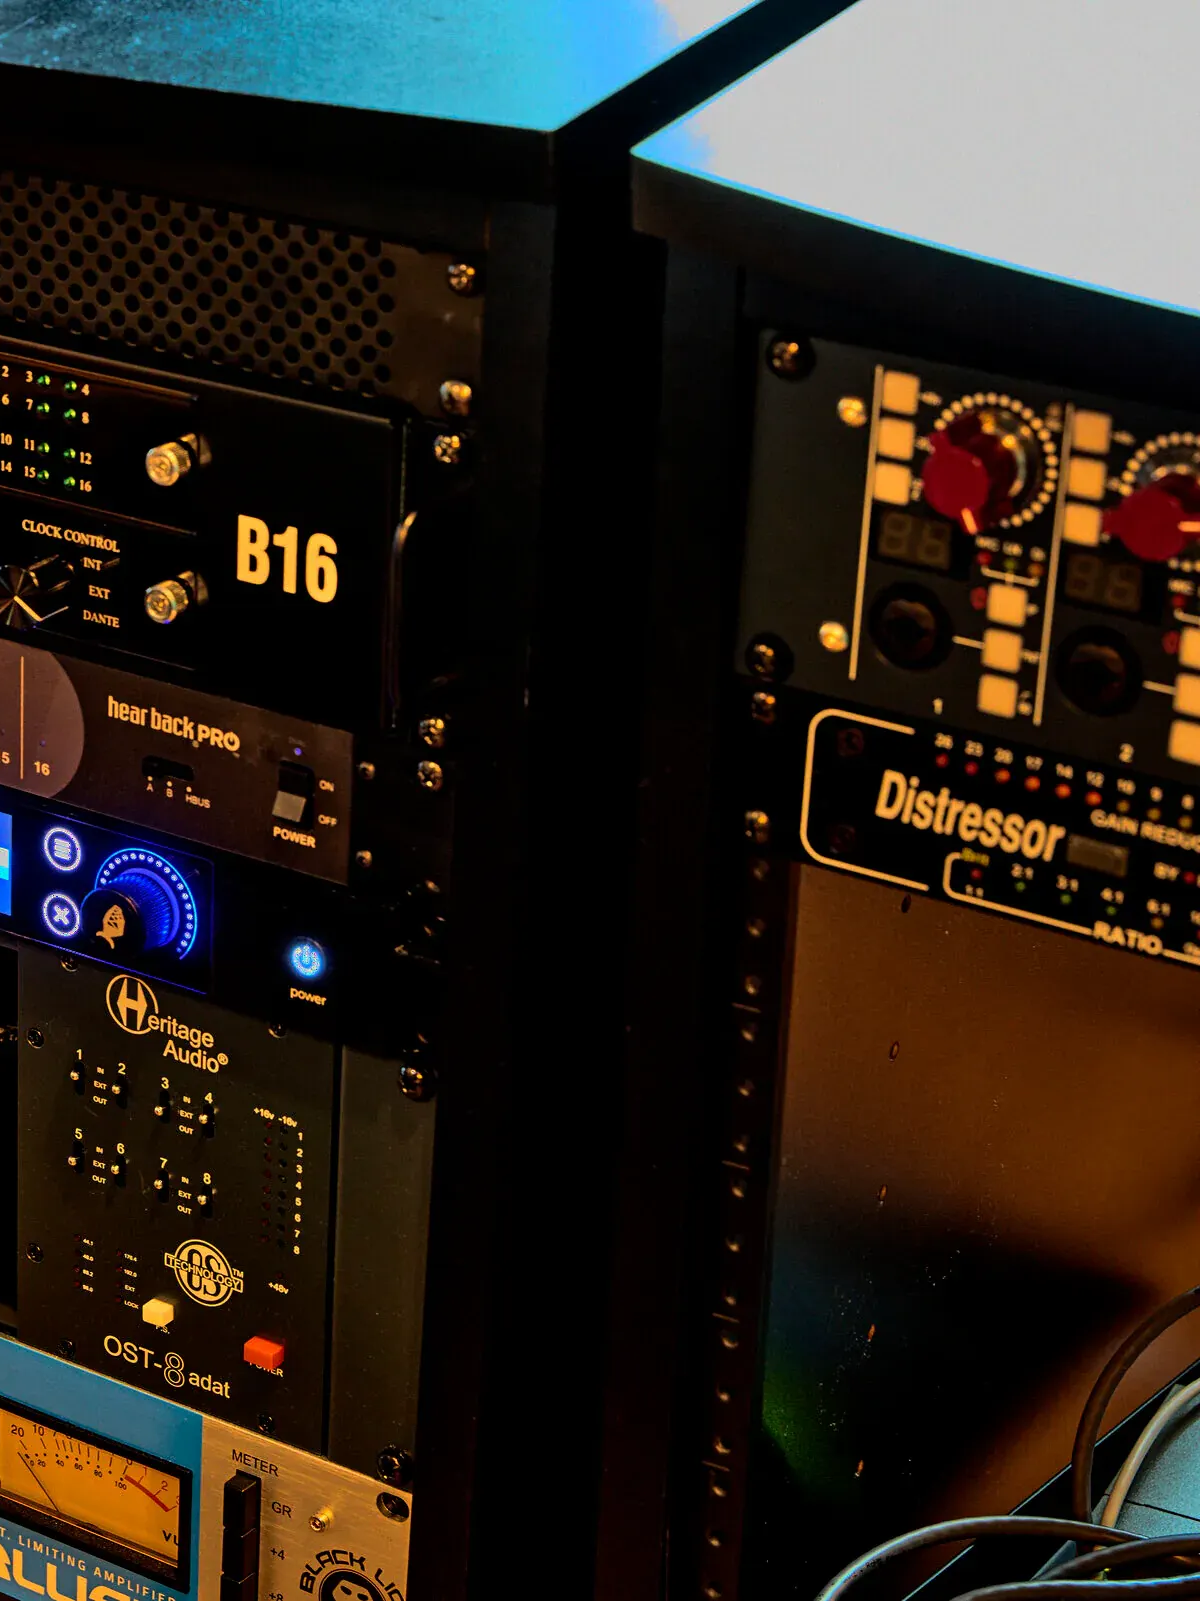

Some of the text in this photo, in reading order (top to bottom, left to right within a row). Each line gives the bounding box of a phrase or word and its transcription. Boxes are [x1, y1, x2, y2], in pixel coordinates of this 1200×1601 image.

[2, 366, 9, 377] 2
[26, 371, 33, 382] 3
[82, 384, 89, 395] 4
[2, 394, 9, 405] 6
[26, 399, 33, 410] 7
[82, 412, 89, 423] 8
[1, 433, 12, 445] 10
[25, 439, 34, 450] 11
[80, 452, 91, 464] 12
[1, 461, 12, 472] 14
[25, 466, 36, 478] 15
[80, 480, 92, 492] 16
[22, 520, 120, 552] CLOCK CONTROL
[84, 557, 102, 570] INT
[237, 515, 337, 602] B16
[89, 585, 110, 599] EXT
[83, 610, 119, 628] DANTE
[108, 696, 240, 751] hear back PRO
[35, 762, 50, 775] 16
[147, 783, 153, 791] A
[320, 780, 334, 791] ON
[319, 815, 336, 825] OFF
[875, 768, 1067, 862] Distressor
[1091, 808, 1138, 834] GAIN
[273, 826, 315, 848] POWER
[1093, 920, 1164, 955] RATIO
[290, 988, 326, 1005] power
[106, 974, 214, 1049] Heritage
[77, 1049, 125, 1074] 1 2
[94, 1081, 107, 1089] EXT
[161, 1077, 213, 1103] 3 4
[93, 1096, 107, 1105] OUT
[179, 1110, 193, 1119] EXT
[75, 1128, 124, 1154] 5 6
[179, 1125, 193, 1134] OUT
[160, 1158, 211, 1184] 7 8
[167, 1256, 240, 1290] TECHNOLOGY
[269, 1283, 288, 1294] +48v
[103, 1334, 230, 1398] OST-8 adat
[11, 1424, 45, 1437] 20 10
[231, 1449, 278, 1478] METER
[115, 1480, 128, 1490] 100
[161, 1480, 169, 1492] 2
[272, 1502, 291, 1518] GR
[19, 1535, 86, 1571] LIMITING
[270, 1547, 284, 1560] +4
[300, 1550, 366, 1594] BLACK
